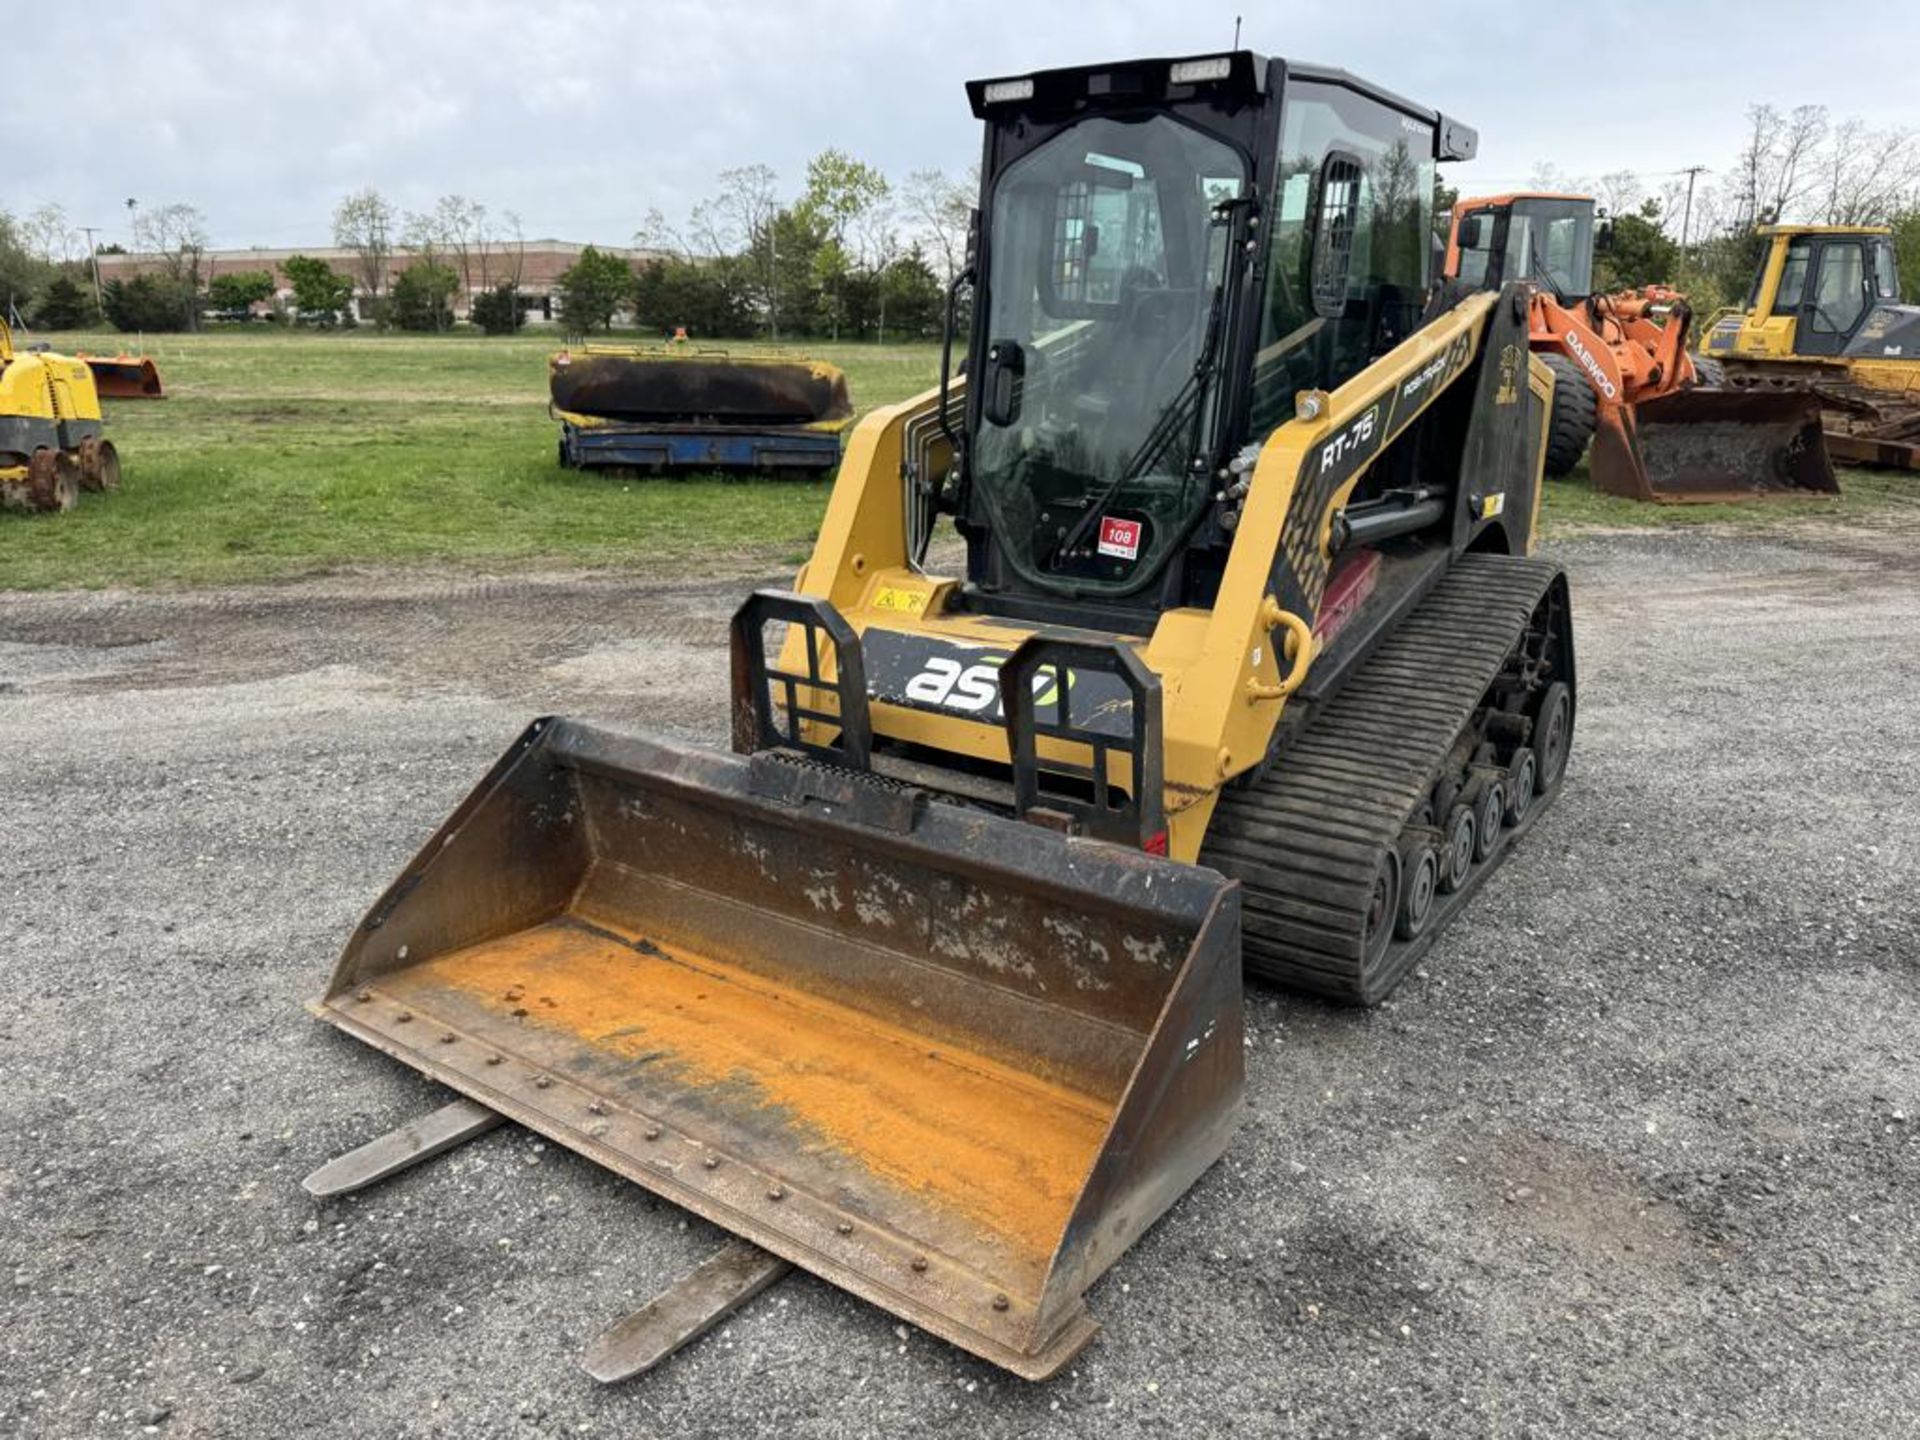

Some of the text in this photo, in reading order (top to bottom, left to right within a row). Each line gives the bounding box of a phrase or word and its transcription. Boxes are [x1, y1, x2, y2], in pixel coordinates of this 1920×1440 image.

[1566, 330, 1616, 399] DAEWOO
[1320, 412, 1374, 474] RT-75
[1108, 527, 1133, 546] 108
